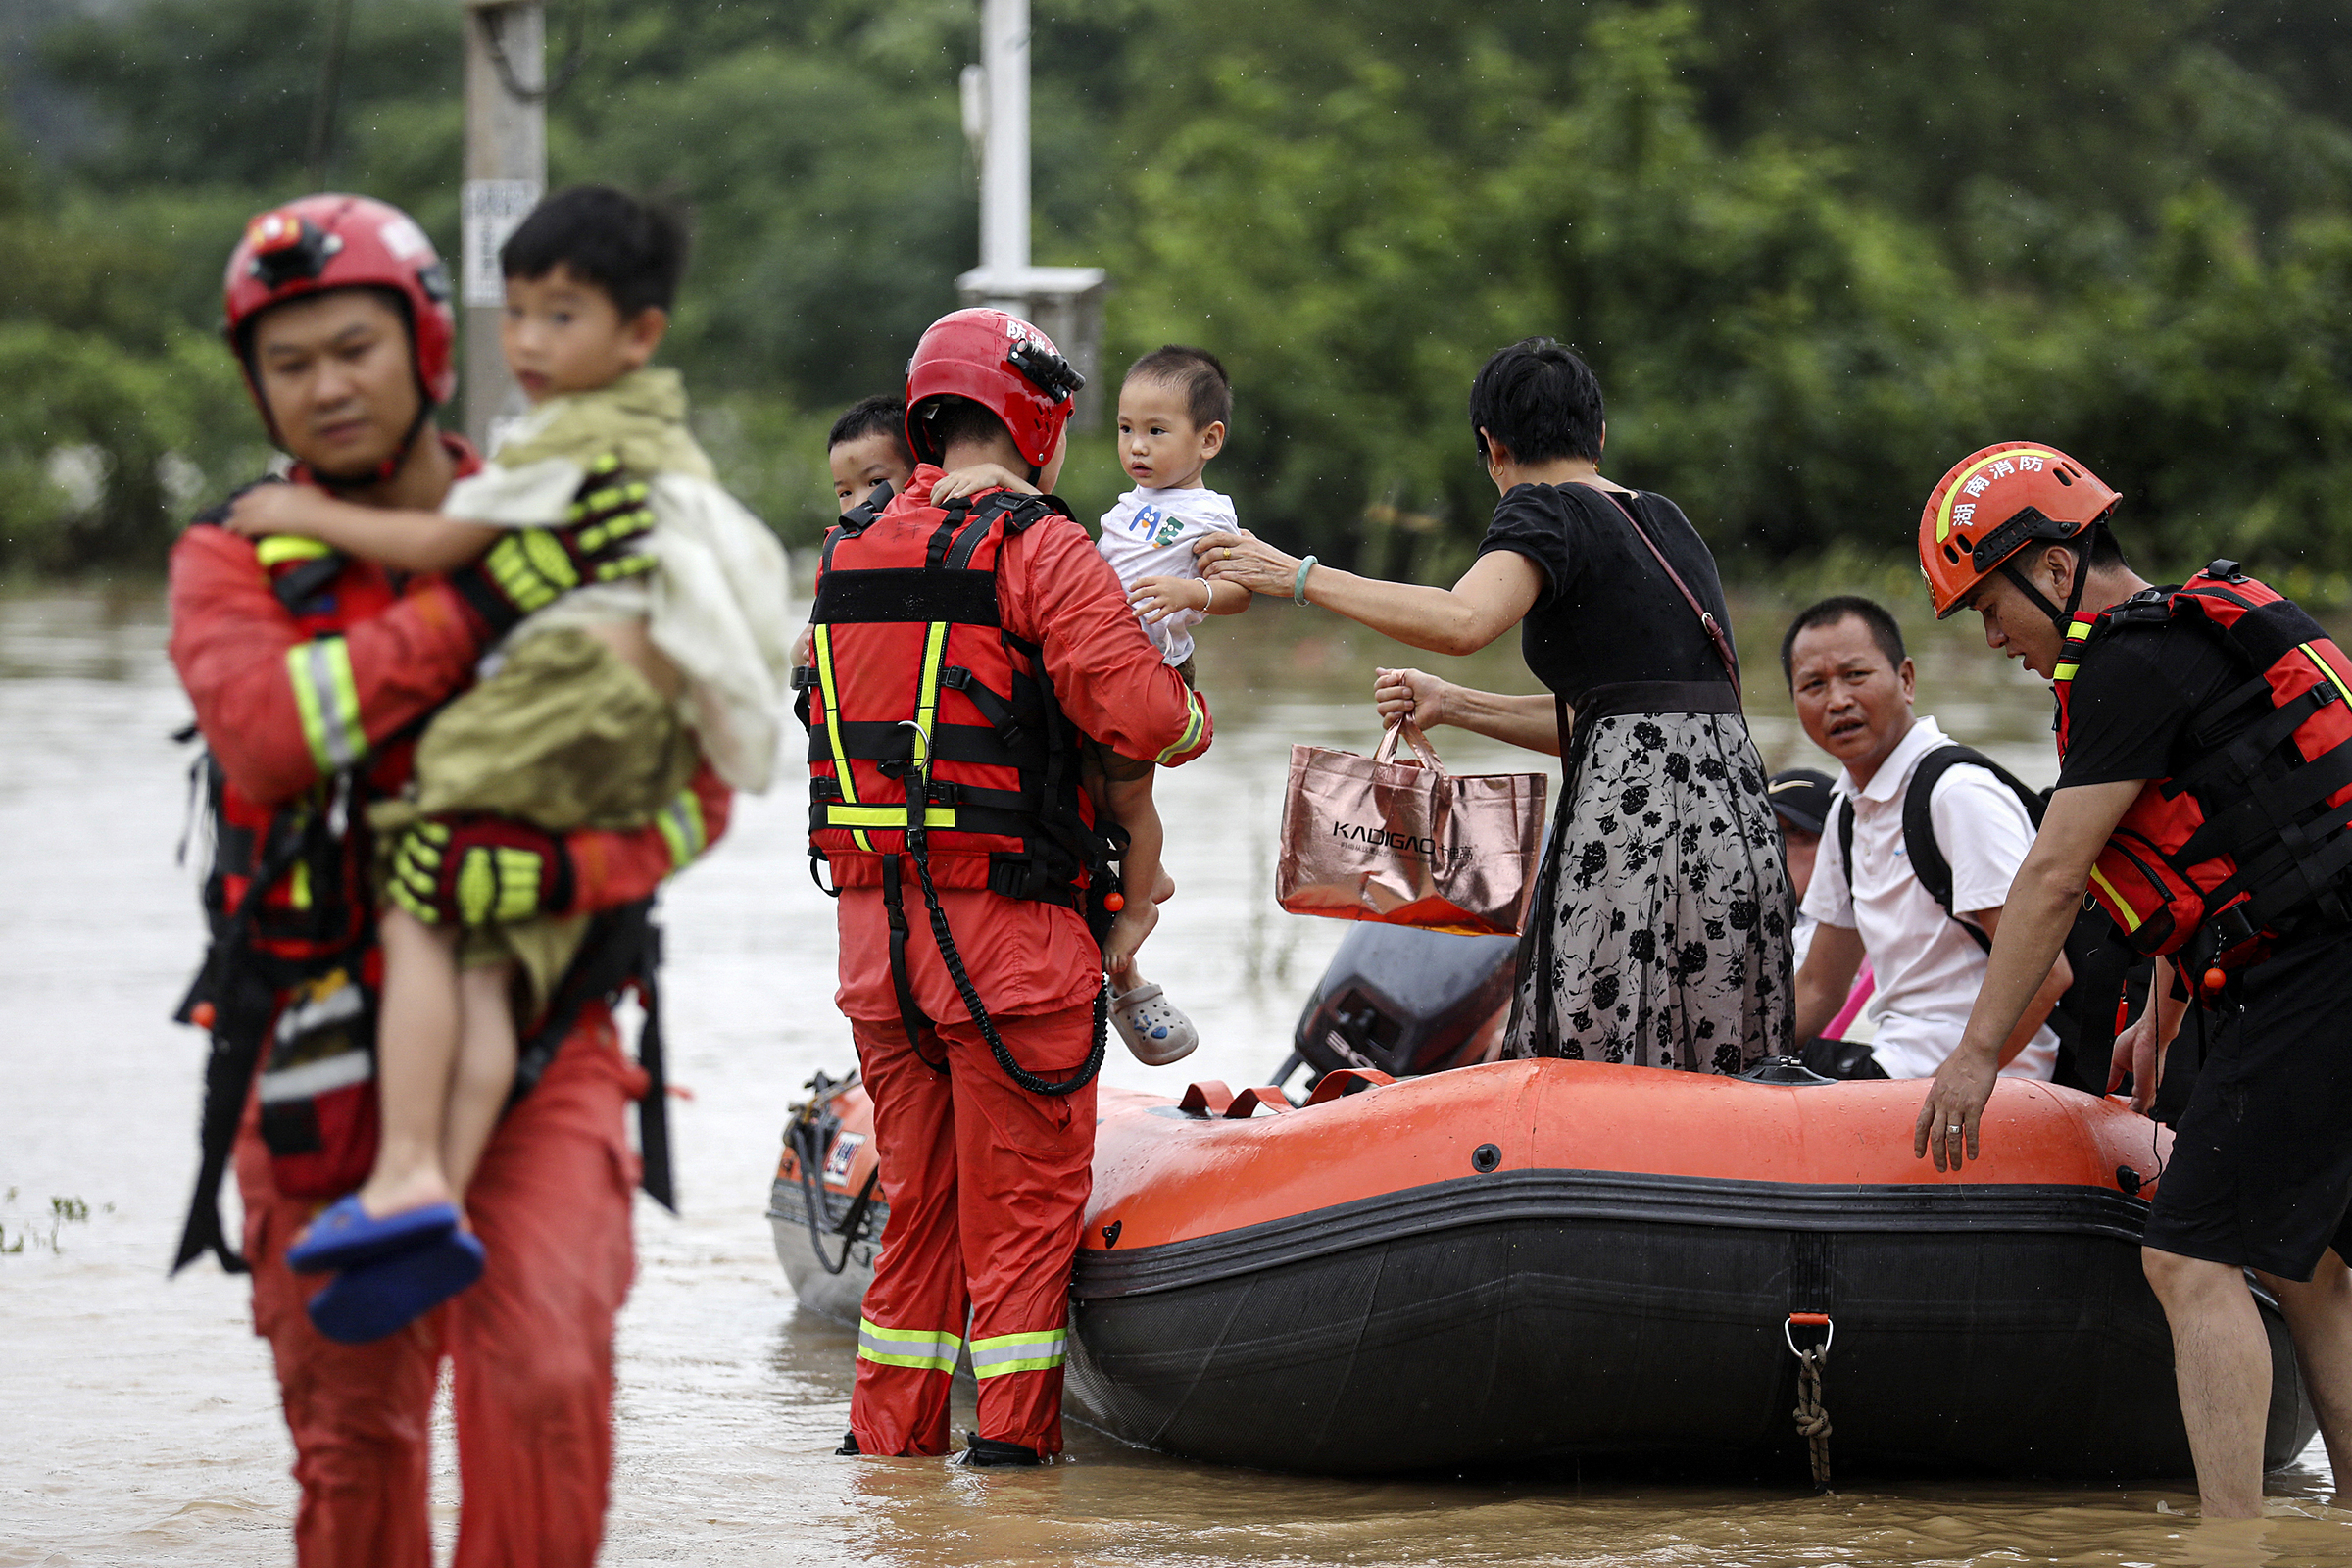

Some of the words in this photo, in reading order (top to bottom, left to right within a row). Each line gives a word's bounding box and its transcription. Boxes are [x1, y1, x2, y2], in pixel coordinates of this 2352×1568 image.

[1952, 456, 2044, 527] 湖南消防
[1333, 821, 1436, 855] KADIGAO
[1438, 843, 1473, 860] 卡迪高
